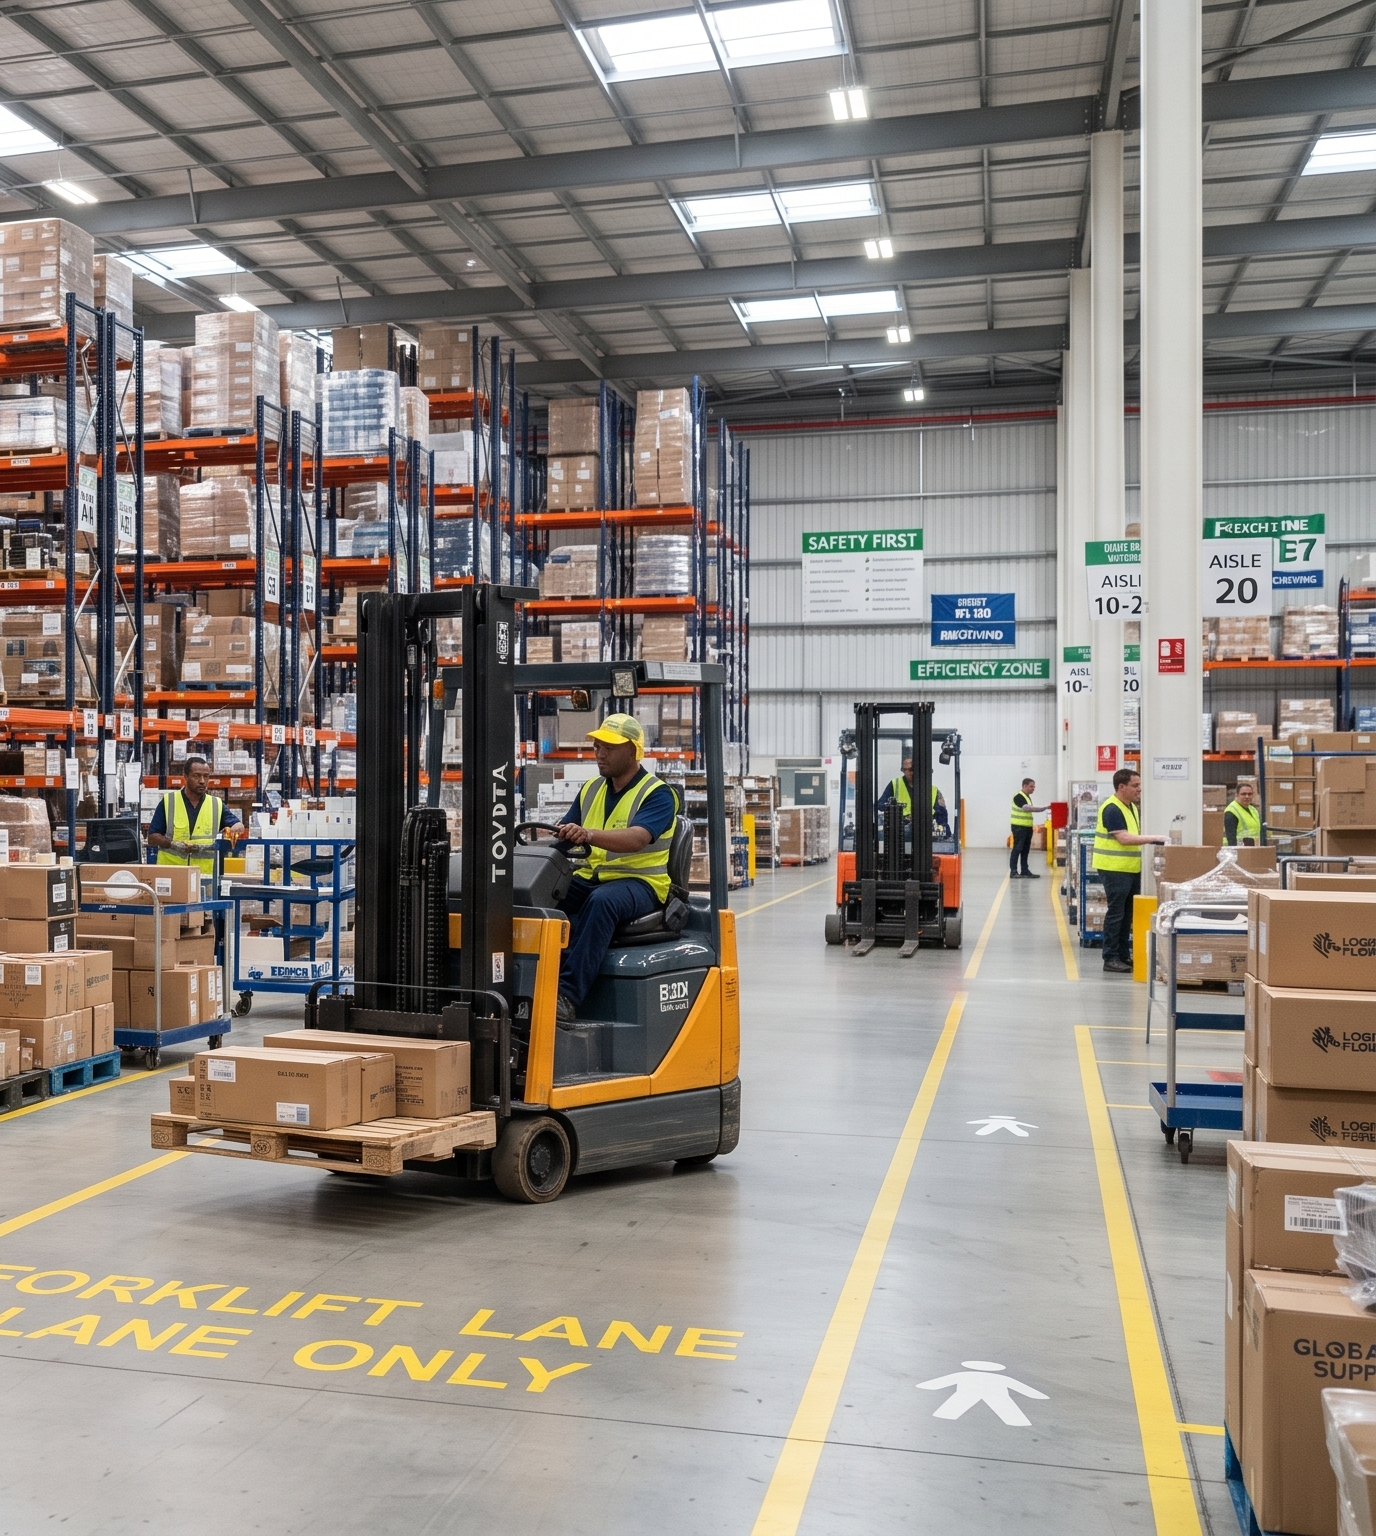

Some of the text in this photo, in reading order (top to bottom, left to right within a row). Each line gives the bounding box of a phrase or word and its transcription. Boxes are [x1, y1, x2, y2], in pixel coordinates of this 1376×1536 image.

[808, 532, 918, 551] SAFETY FIRST
[1279, 538, 1317, 563] E7
[1209, 553, 1262, 569] AISLE
[1215, 577, 1259, 604] 20
[917, 662, 1042, 677] EFFICIENCY ZONE
[459, 1308, 746, 1362] LANE
[293, 1338, 593, 1394] ONLY
